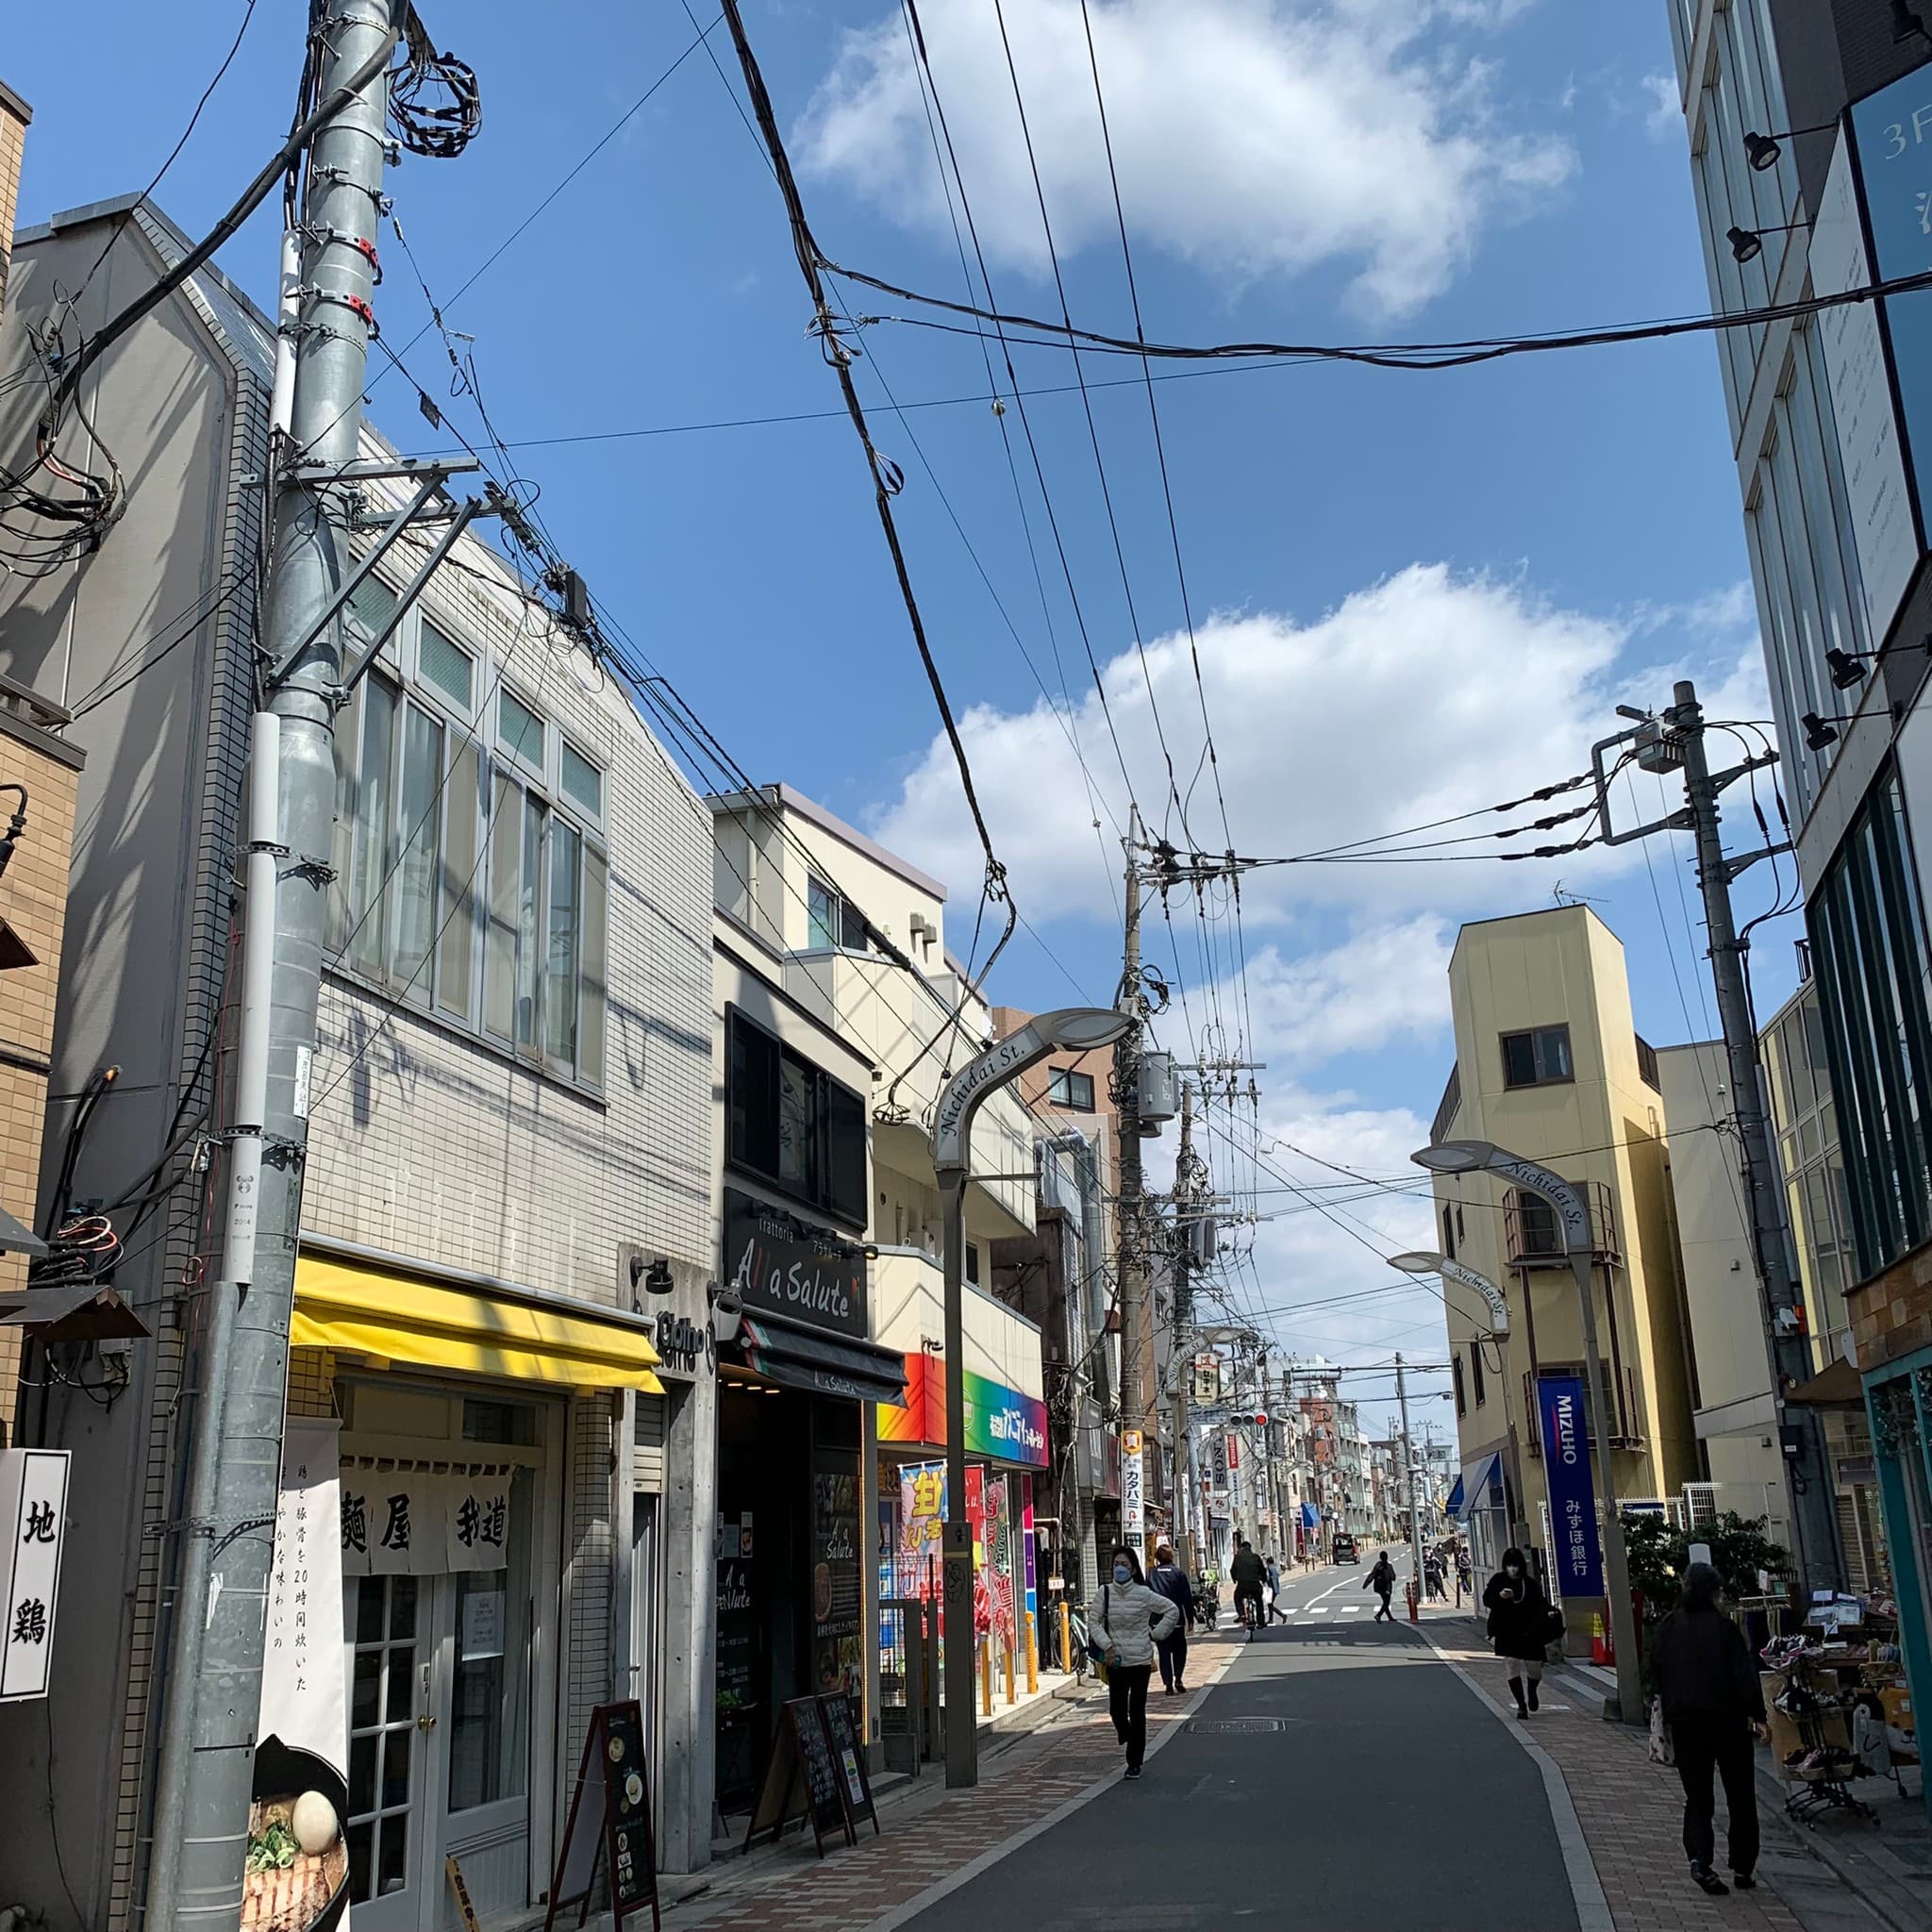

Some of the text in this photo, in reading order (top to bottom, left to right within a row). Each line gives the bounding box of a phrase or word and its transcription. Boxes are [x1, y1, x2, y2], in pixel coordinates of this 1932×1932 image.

[941, 1045, 1026, 1137] Nichidai St.
[1506, 1162, 1584, 1230] Nichidai St.
[786, 1261, 849, 1318] Salute
[1455, 1267, 1496, 1302] Nichidai
[1557, 1394, 1577, 1465] MIZUHO
[11, 1500, 57, 1646] 地鶏
[1566, 1499, 1589, 1577] みずほ銀行
